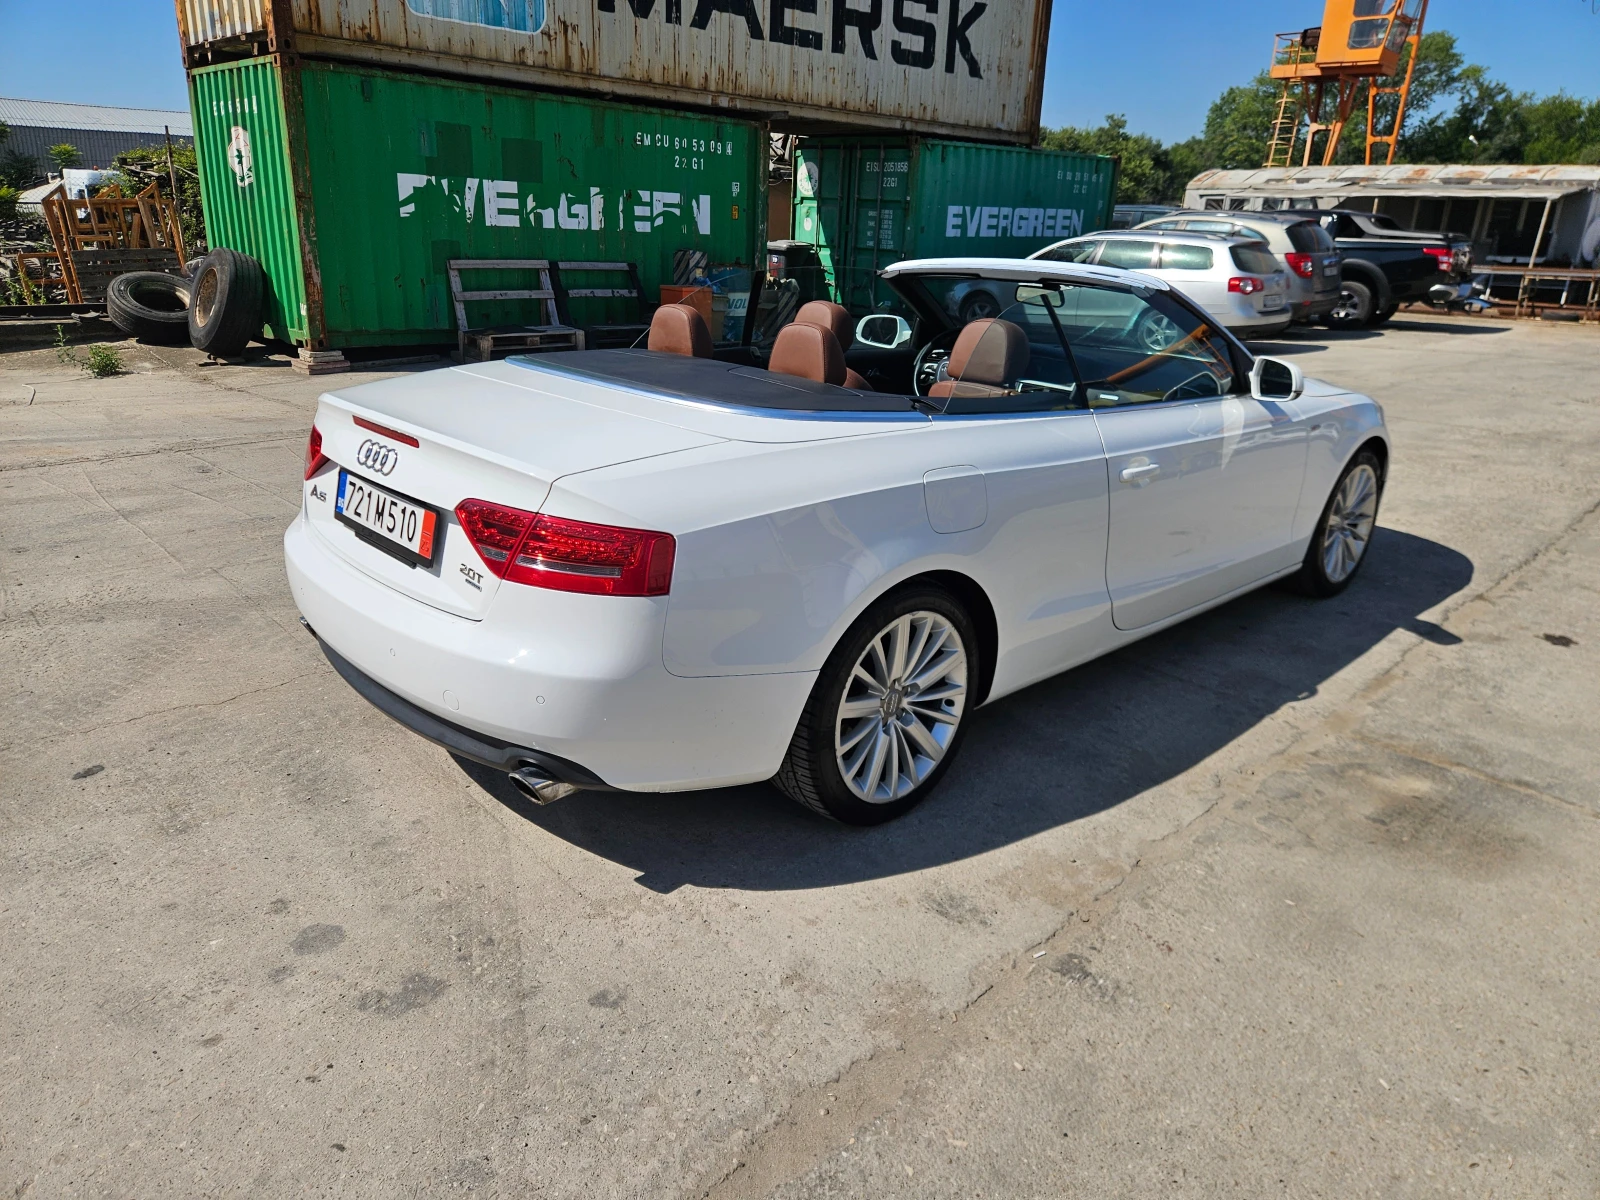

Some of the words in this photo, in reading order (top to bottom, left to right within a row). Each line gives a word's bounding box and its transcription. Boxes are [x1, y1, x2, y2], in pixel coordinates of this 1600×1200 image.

[597, 0, 988, 80] ERSK
[945, 205, 1085, 238] EVERGREEN
[310, 484, 328, 504] A5
